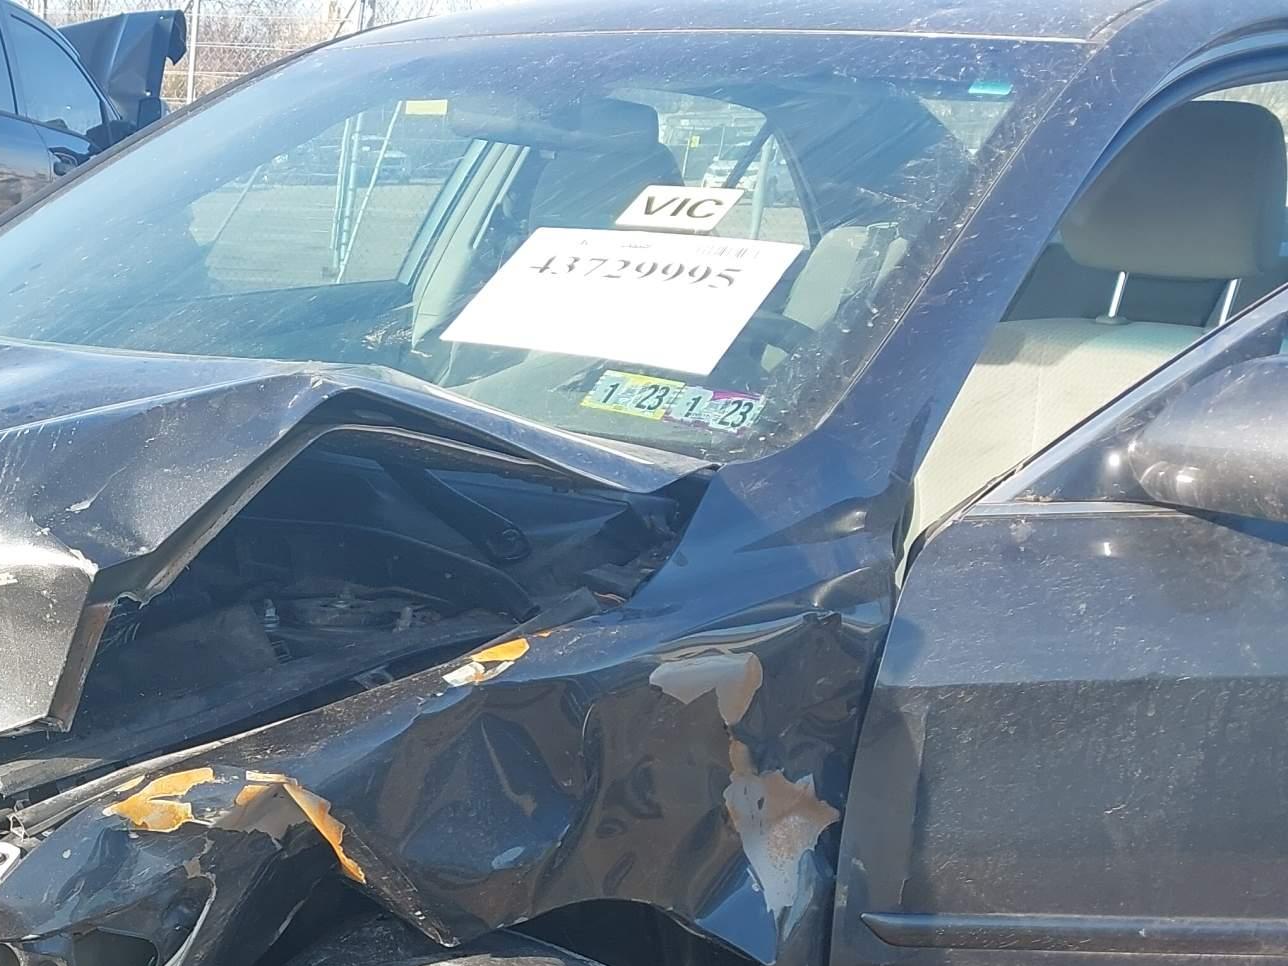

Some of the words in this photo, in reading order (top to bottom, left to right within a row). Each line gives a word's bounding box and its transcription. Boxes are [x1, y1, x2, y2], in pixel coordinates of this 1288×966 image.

[643, 195, 724, 219] VIC
[529, 255, 744, 288] 43729995
[602, 383, 620, 404] 1
[635, 384, 671, 411] 23
[684, 395, 702, 418] 1
[717, 400, 754, 428] 23
